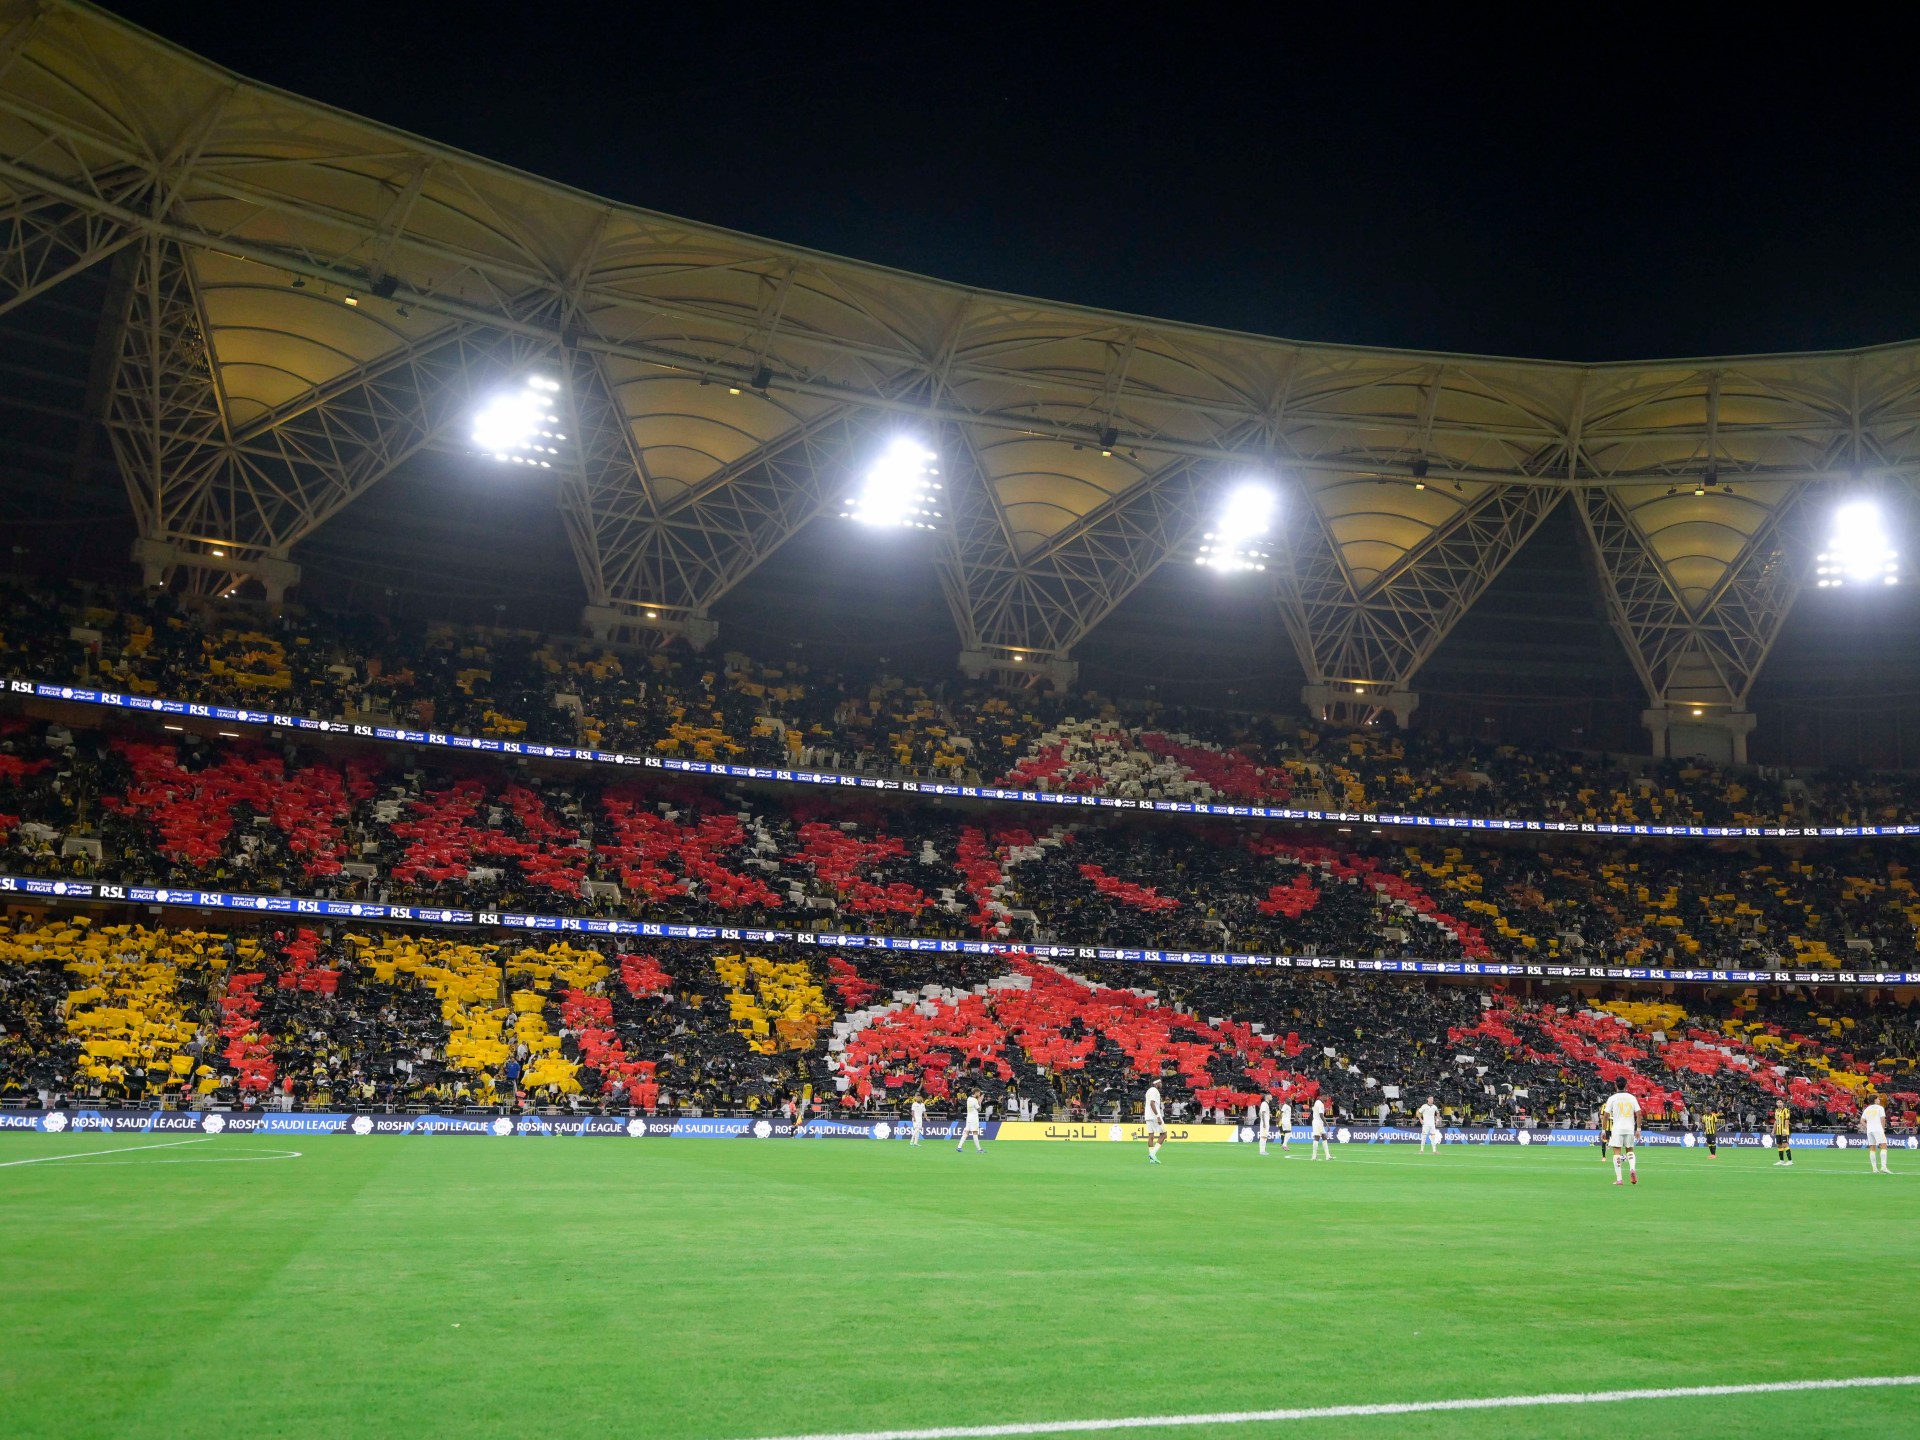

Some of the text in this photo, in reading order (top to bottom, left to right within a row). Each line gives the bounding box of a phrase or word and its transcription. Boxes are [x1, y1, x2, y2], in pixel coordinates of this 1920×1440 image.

[11, 682, 34, 693] RSL
[102, 694, 122, 705] RSL
[190, 705, 210, 716] RSL
[274, 716, 293, 726] RSL
[354, 726, 373, 736] RSL
[429, 734, 447, 744] RSL
[504, 743, 521, 753] RSL
[576, 751, 593, 760] RSL
[645, 758, 662, 767] RSL
[711, 765, 727, 774] RSL
[777, 771, 792, 780] RSL
[840, 777, 856, 786] RSL
[903, 782, 918, 791] RSL
[963, 787, 977, 796] RSL
[1023, 792, 1037, 800] RSL
[1082, 796, 1096, 805] RSL
[1140, 801, 1154, 809] RSL
[1195, 804, 1209, 813] RSL
[1252, 808, 1266, 816] RSL
[0, 878, 17, 890] SL
[100, 886, 125, 898] RSL
[200, 893, 224, 906] RSL
[298, 901, 320, 912] RSL
[390, 908, 412, 919] RSL
[479, 914, 500, 925] RSL
[561, 919, 581, 930] RSL
[643, 925, 662, 935] RSL
[722, 929, 740, 939] RSL
[798, 934, 816, 944] RSL
[941, 941, 958, 951] RSL
[1011, 945, 1028, 954] RSL
[1080, 948, 1096, 958] RSL
[1145, 951, 1161, 961] RSL
[1211, 954, 1227, 964] RSL
[1276, 957, 1292, 966] RSL
[1340, 960, 1356, 969] RSL
[1402, 962, 1417, 971] RSL
[1465, 964, 1480, 973] RSL
[1528, 967, 1543, 975] RSL
[1590, 969, 1605, 977] RSL
[1618, 1102, 1633, 1118] 12
[0, 1116, 38, 1127] EAGUE
[72, 1118, 196, 1128] ROSHN SAUDI LEAGUE
[229, 1120, 347, 1130] ROSHN SAUDI LEAGUE
[377, 1121, 488, 1131] ROSHN SAUDI LEAGUE
[517, 1122, 622, 1133] ROSHN SAUDI LEAGUE
[650, 1124, 749, 1134] ROSHN SAUDI LEAGUE
[809, 1126, 836, 1135] SAUDI
[838, 1126, 869, 1135] LEAGUE
[926, 1127, 951, 1136] SAUDI
[1045, 1126, 1097, 1141] ناديك
[1353, 1132, 1377, 1140] ROSHN
[1379, 1132, 1400, 1141] SAUDI
[1445, 1133, 1514, 1142] ROSHN SAUDI LEAGUE
[1533, 1134, 1600, 1143] ROSHN SAUDI LEAGUE
